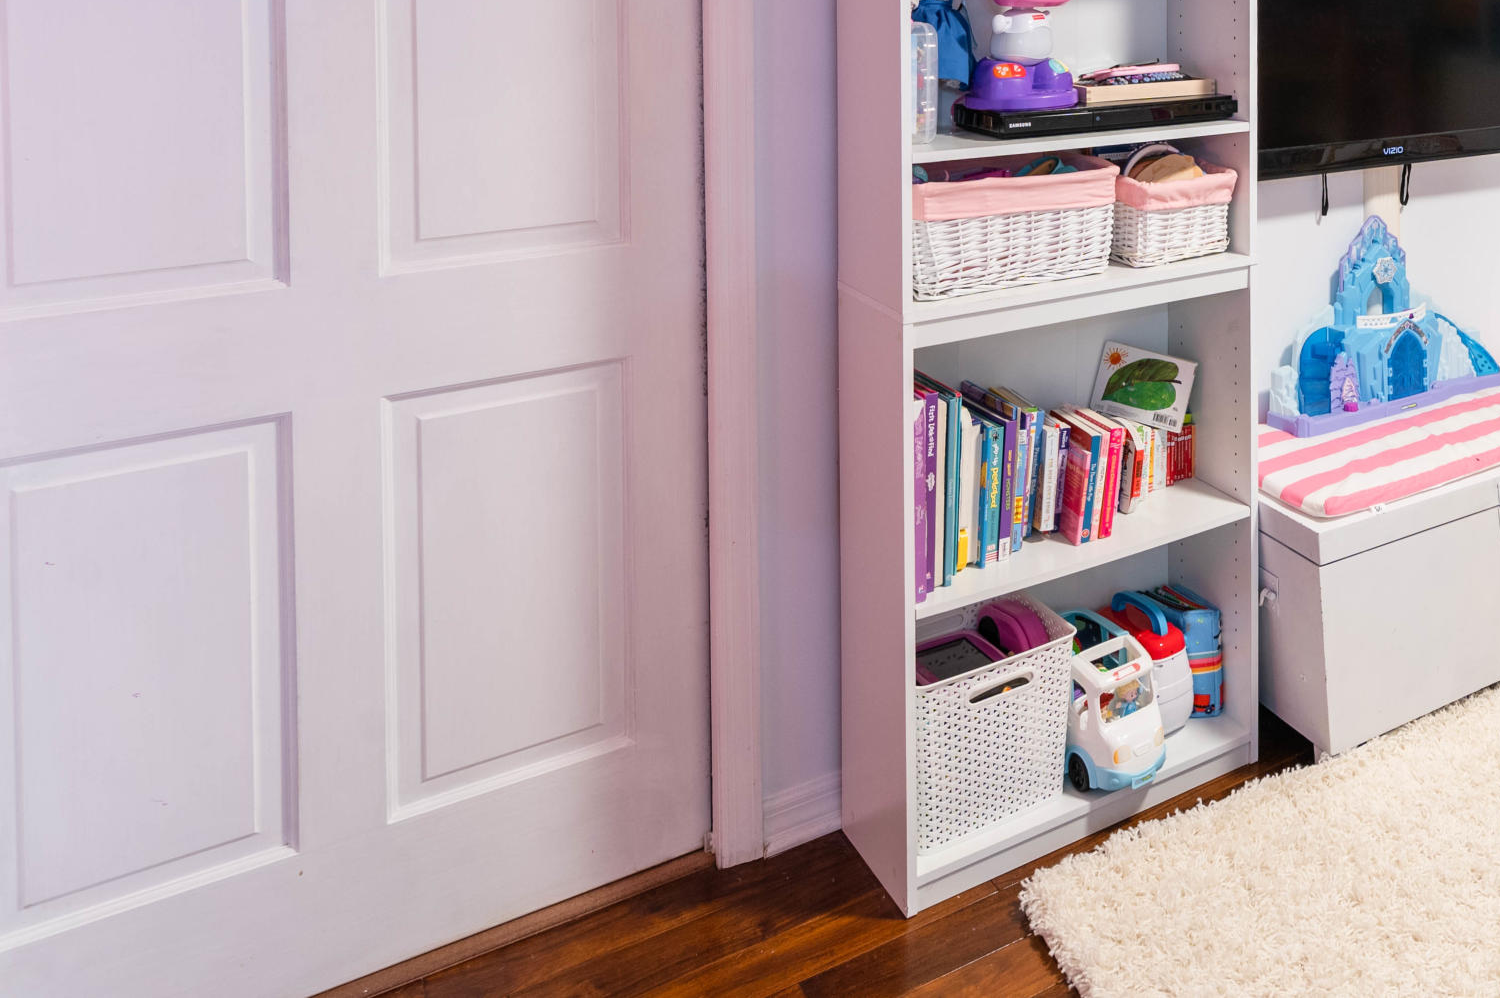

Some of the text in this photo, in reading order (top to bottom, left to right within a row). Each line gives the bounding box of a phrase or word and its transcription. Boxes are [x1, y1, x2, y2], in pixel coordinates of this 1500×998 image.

[1008, 121, 1032, 129] SAMSUNG
[1383, 145, 1404, 155] VIZIO
[928, 404, 937, 423] First
[927, 442, 935, 457] Find
